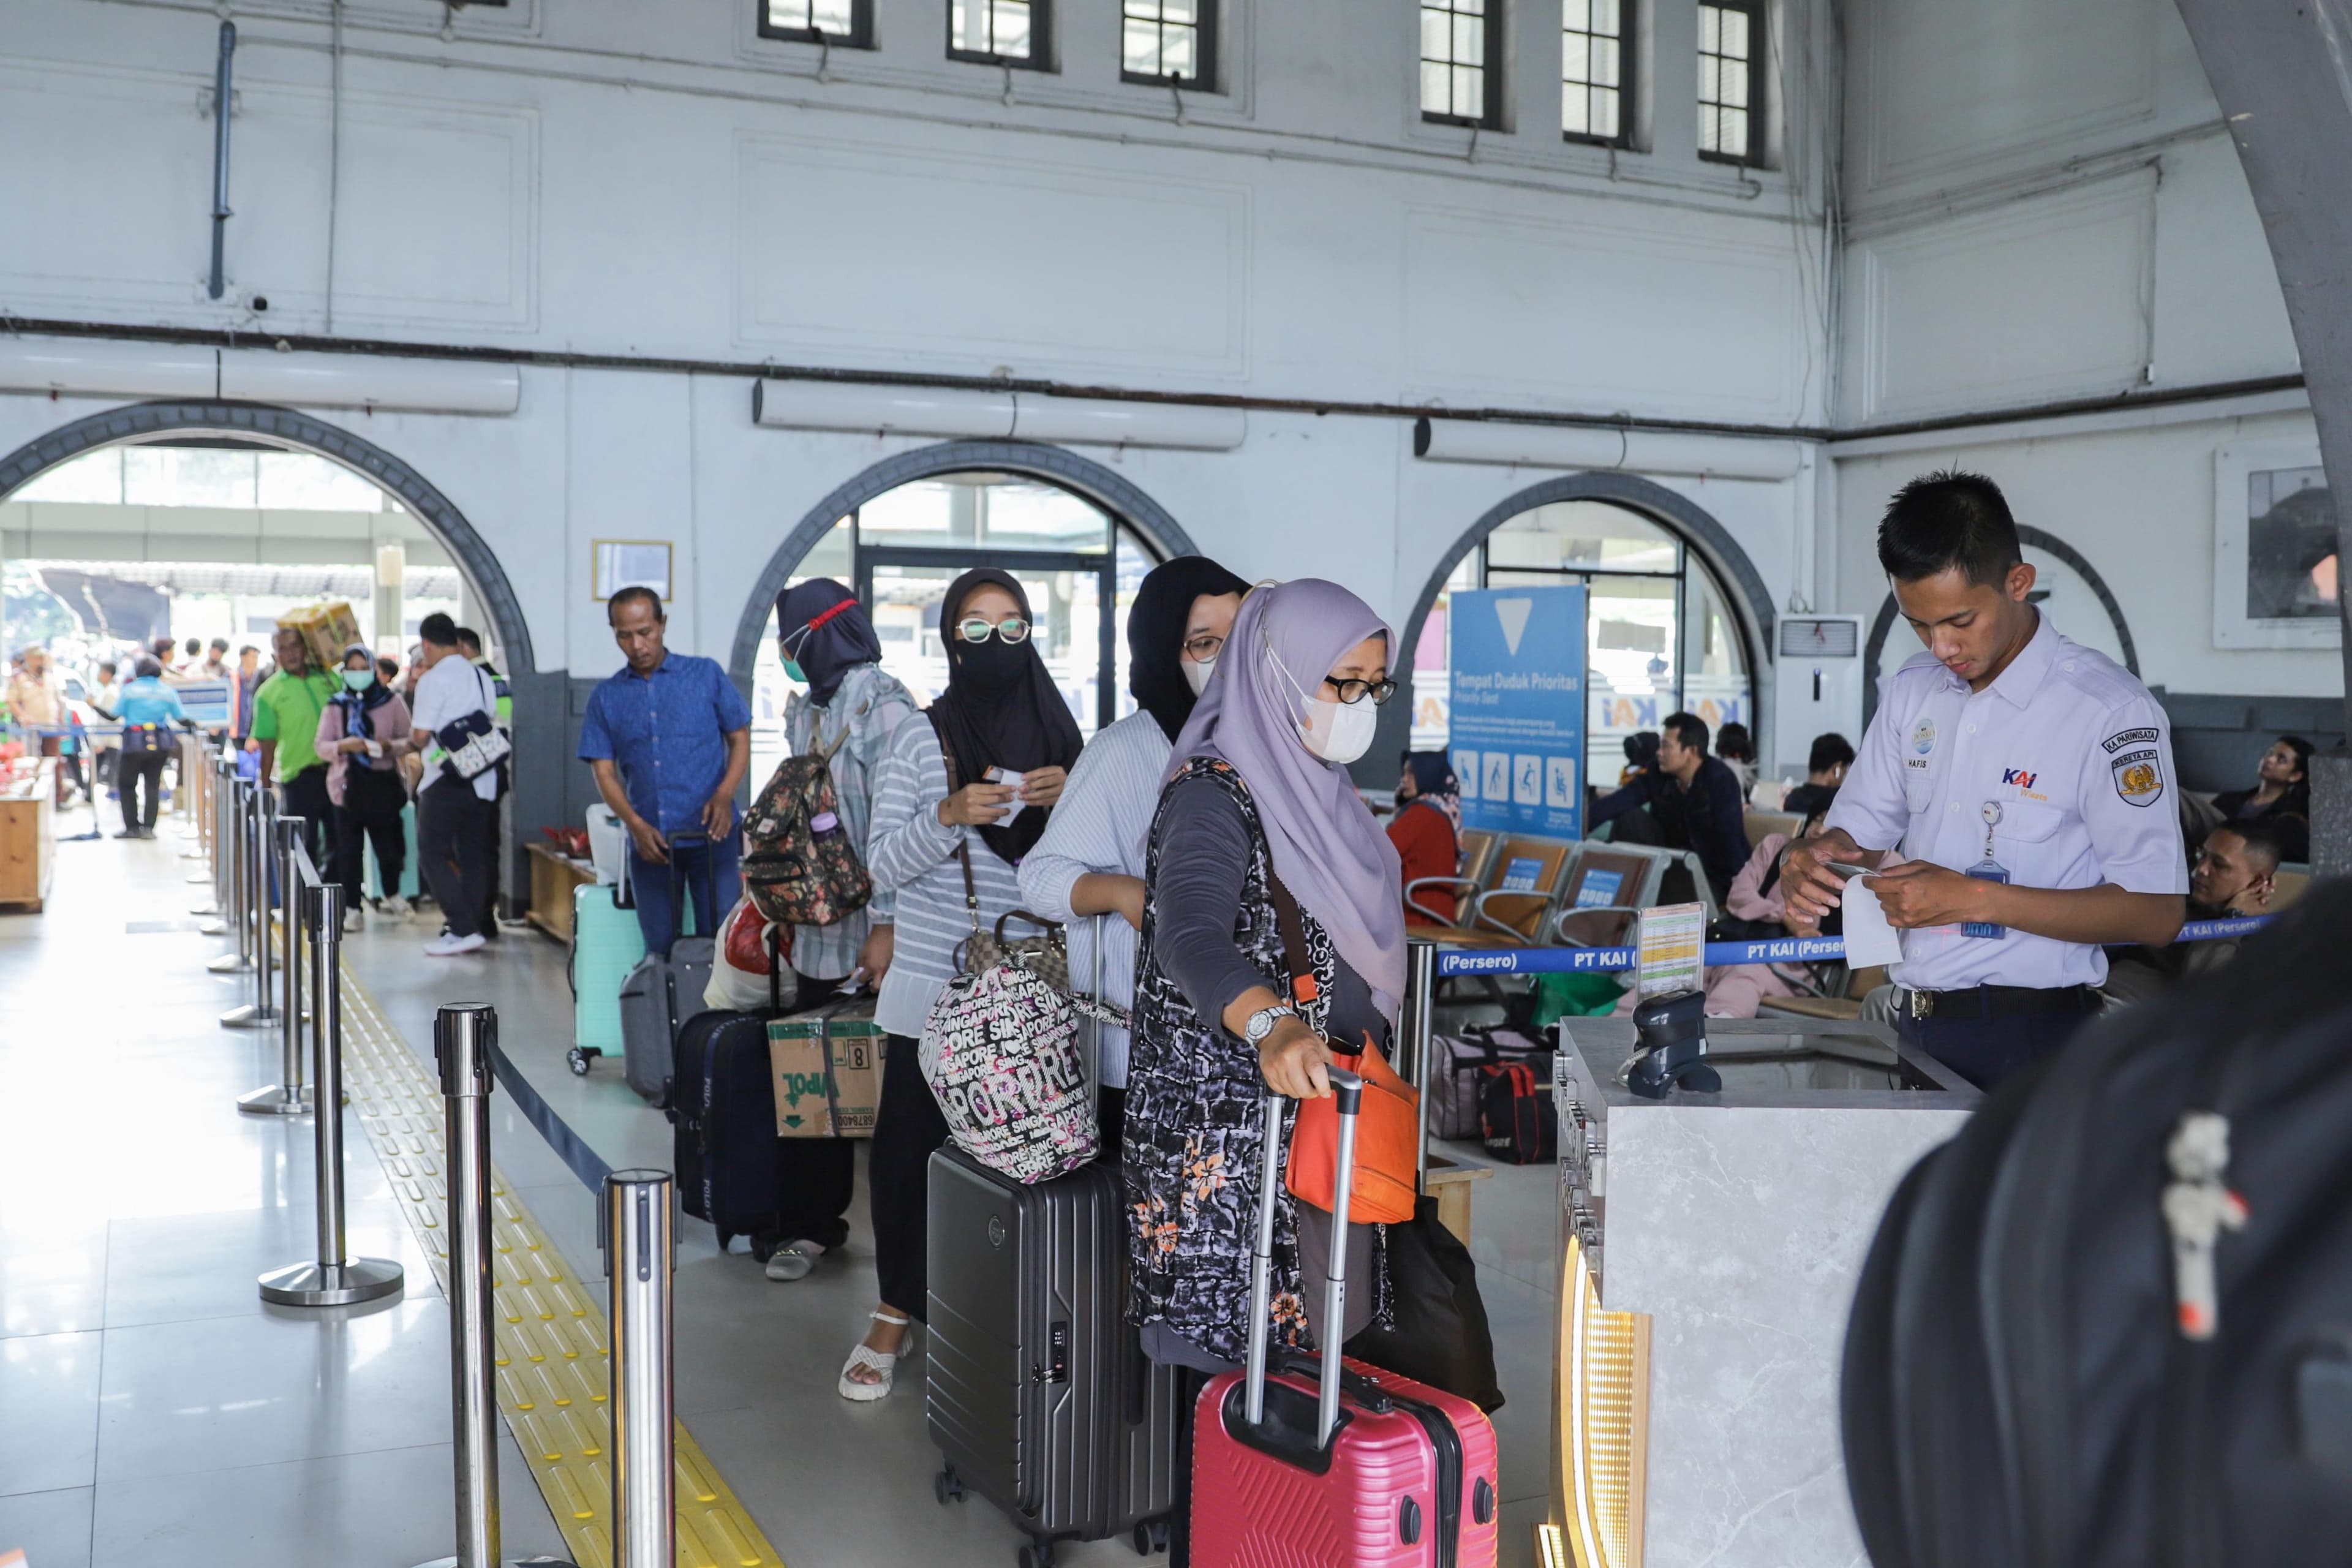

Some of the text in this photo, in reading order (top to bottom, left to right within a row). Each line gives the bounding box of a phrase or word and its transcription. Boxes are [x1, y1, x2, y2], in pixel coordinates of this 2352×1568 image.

[1454, 671, 1578, 691] Tempat Duduk Prioritas
[2106, 731, 2155, 750] KA PARIWISATA
[1908, 759, 1927, 769] HAFIS
[2115, 753, 2142, 766] KERETA
[2002, 767, 2038, 789] KAI
[2193, 924, 2212, 936] KAI
[1748, 940, 1845, 959] PT KAI (Perser
[1442, 952, 1517, 973] (Persero)
[1574, 952, 1596, 967] PT
[1599, 951, 1627, 966] KAI
[854, 1047, 863, 1067] 8
